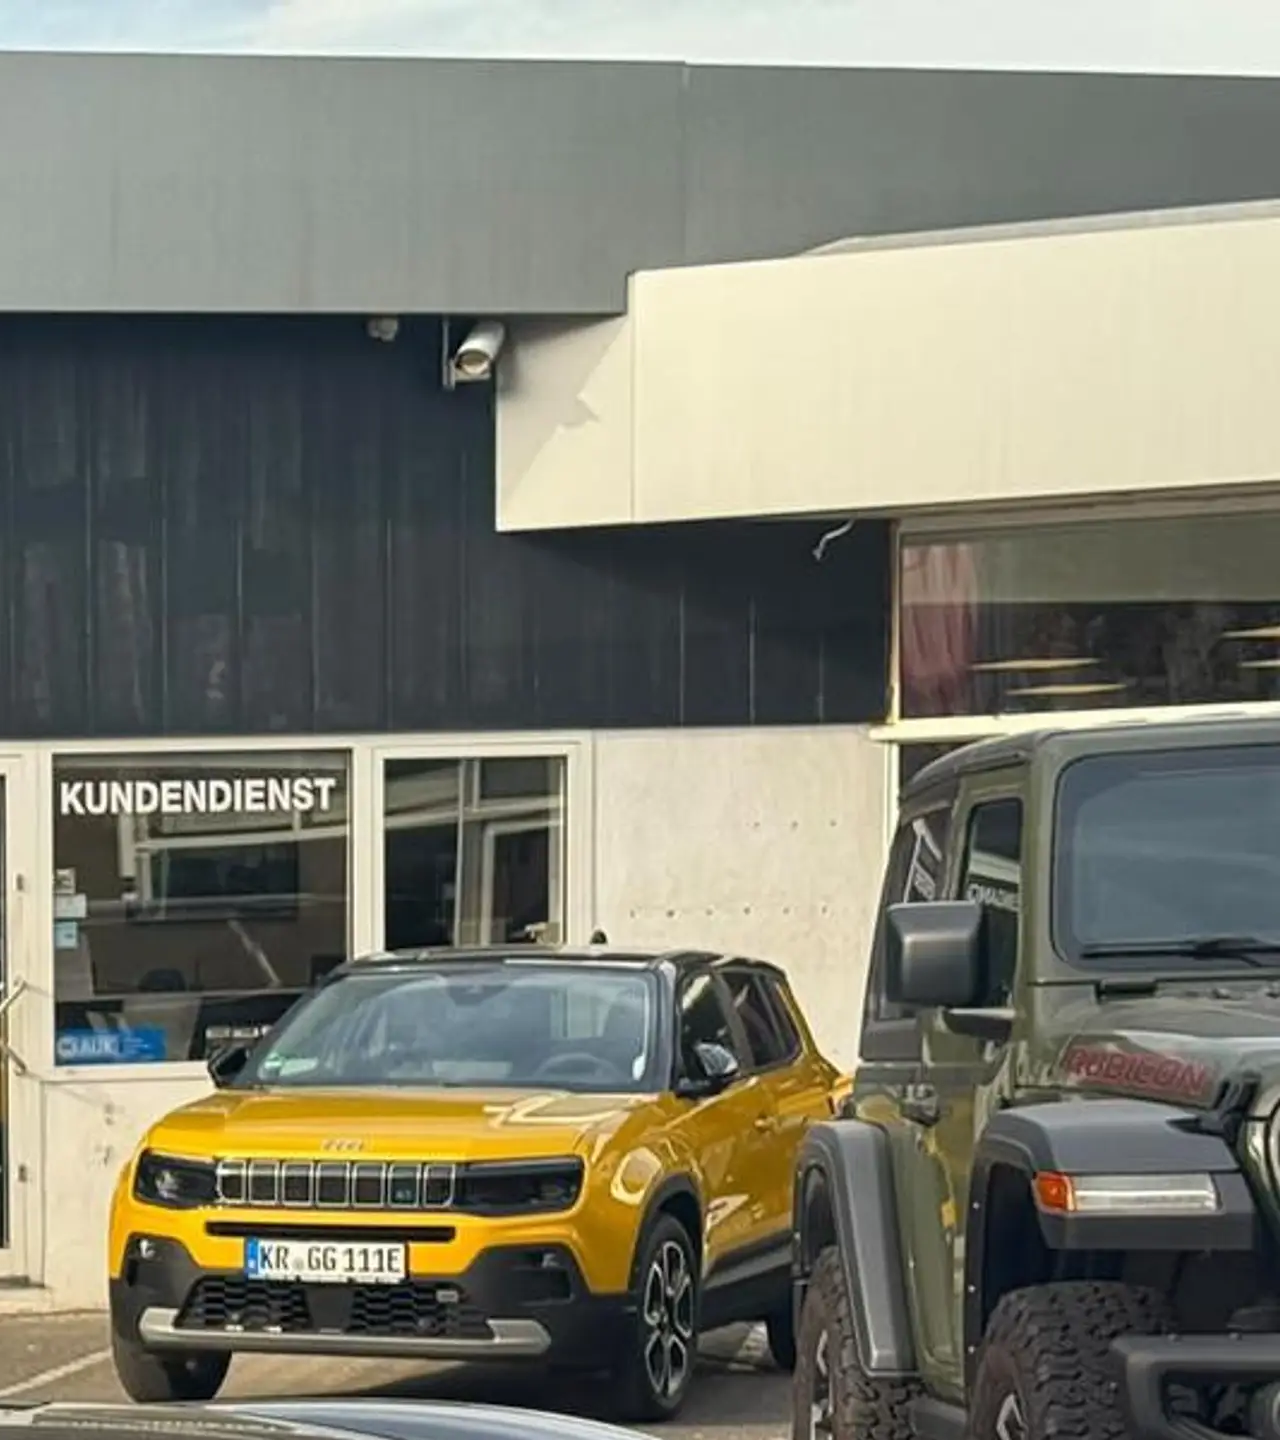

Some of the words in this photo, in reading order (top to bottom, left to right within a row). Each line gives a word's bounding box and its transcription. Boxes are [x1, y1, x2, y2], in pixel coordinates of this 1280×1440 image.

[59, 777, 336, 816] KUNDENDIENST
[1067, 1048, 1208, 1093] RUBICON
[259, 1245, 290, 1270] KR
[307, 1246, 337, 1272] GG
[342, 1247, 401, 1273] 111E
